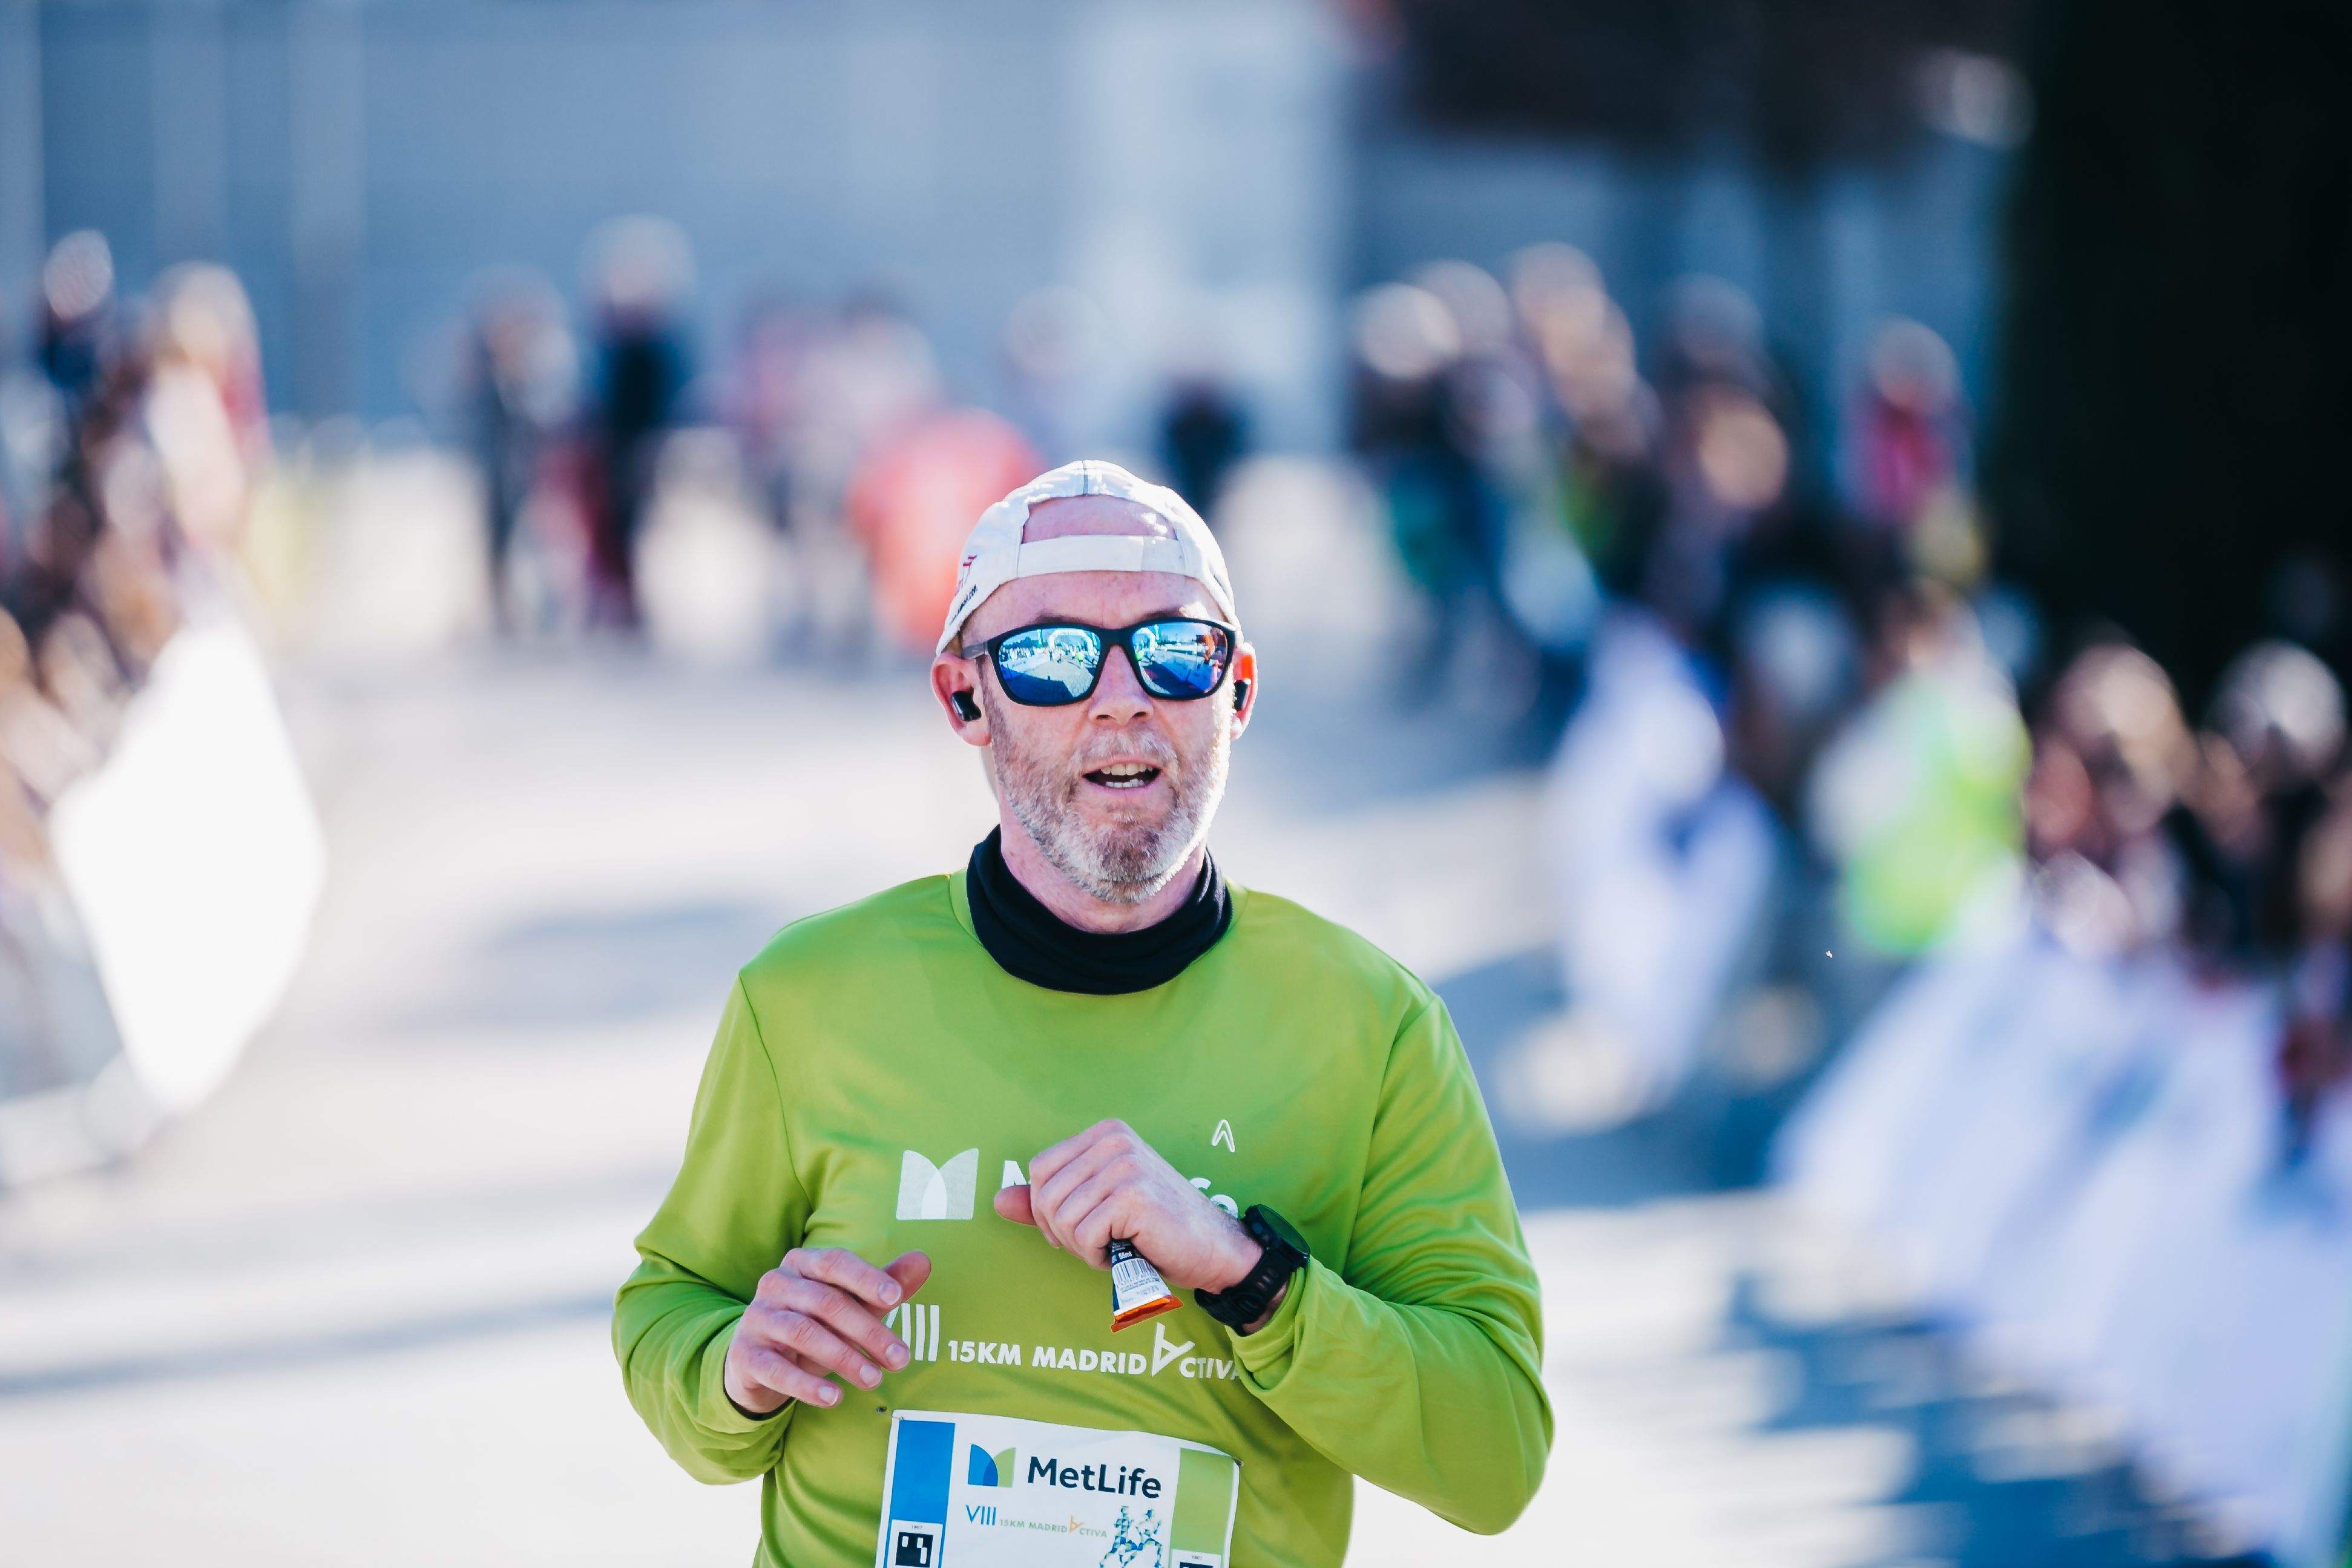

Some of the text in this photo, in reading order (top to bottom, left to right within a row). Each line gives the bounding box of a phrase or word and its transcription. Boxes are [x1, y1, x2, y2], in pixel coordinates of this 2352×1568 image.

[948, 1340, 1022, 1366] 15KM
[1031, 1345, 1148, 1375] MADRID
[1028, 1455, 1161, 1498] MetLife
[965, 1504, 996, 1526] VIII
[999, 1519, 1025, 1528] 15KM
[1029, 1522, 1068, 1533] MADRID
